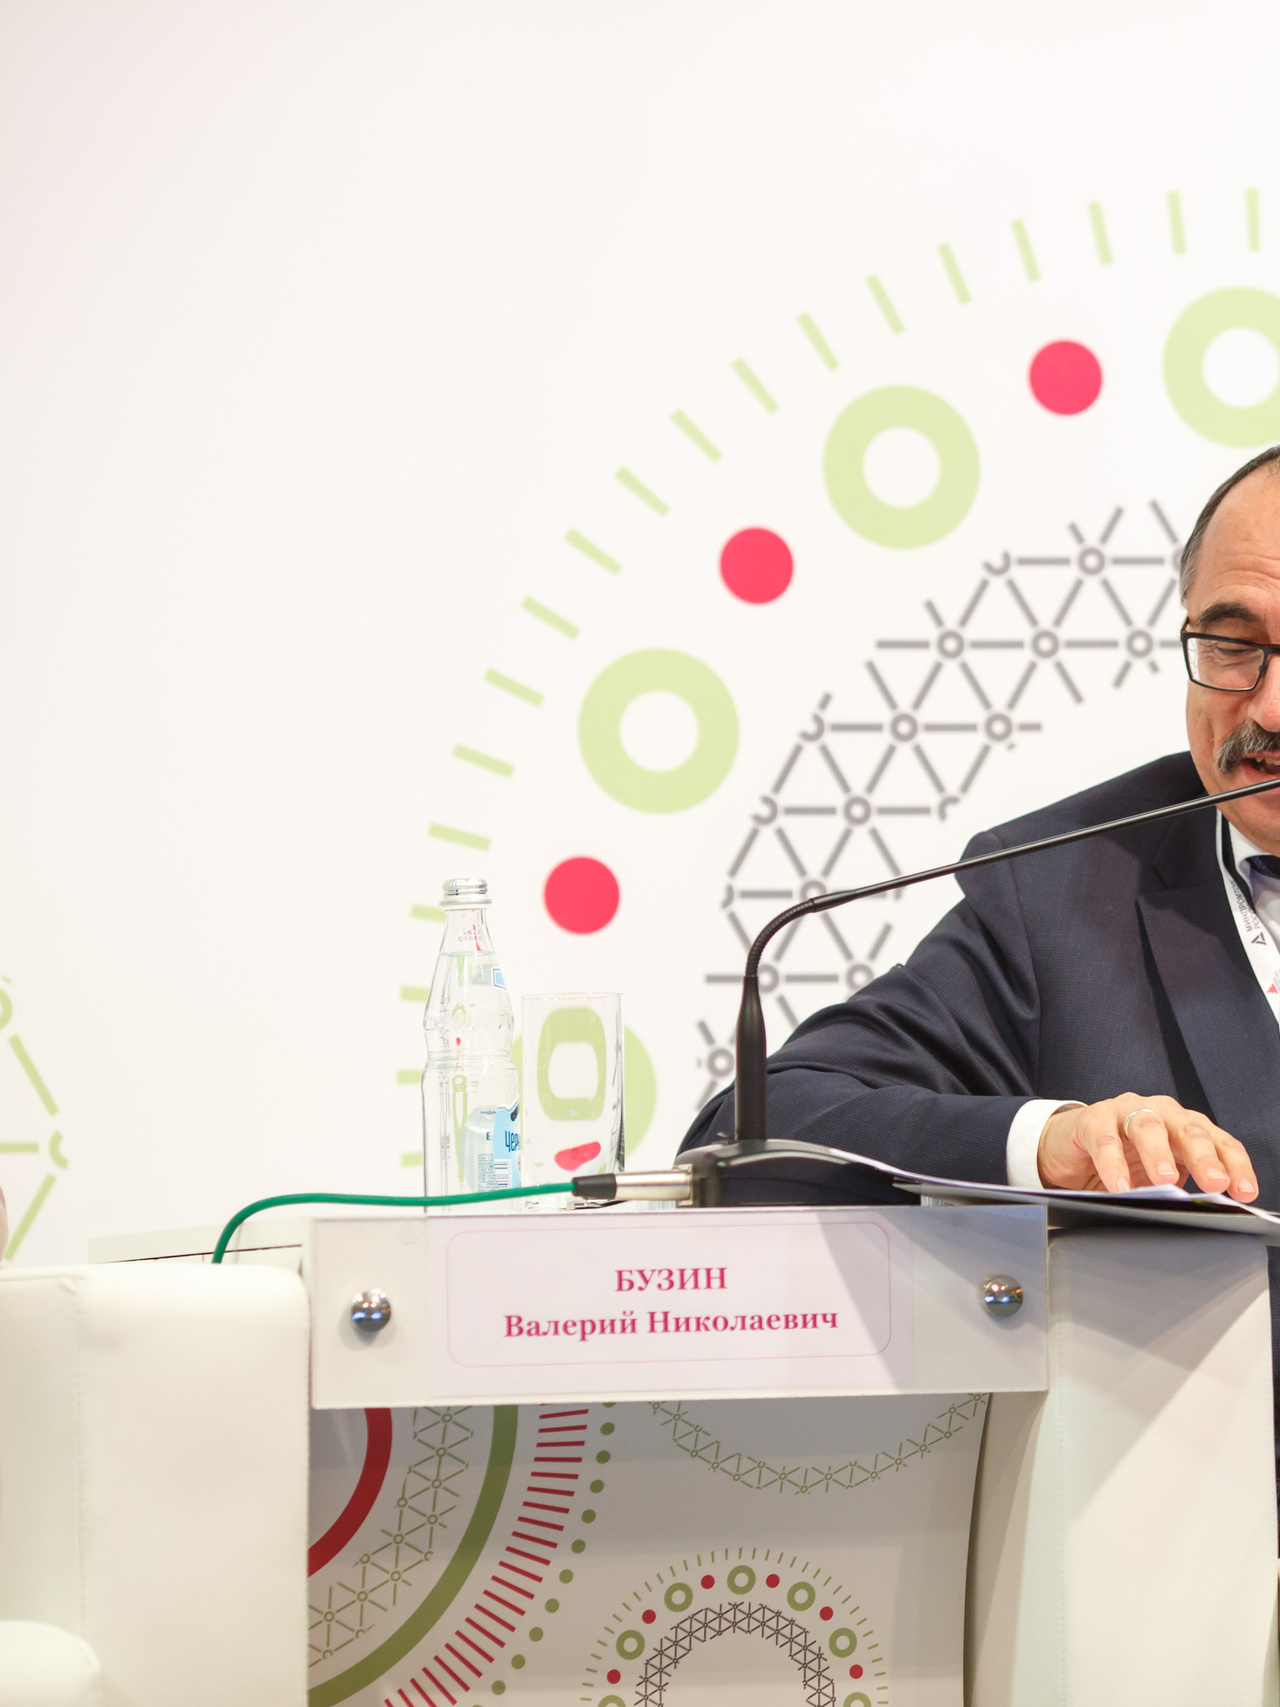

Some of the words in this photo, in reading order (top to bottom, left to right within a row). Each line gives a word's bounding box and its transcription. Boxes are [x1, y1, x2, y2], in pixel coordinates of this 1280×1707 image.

[615, 1267, 728, 1292] БУЗИН
[504, 1310, 638, 1342] Валерий
[647, 1310, 839, 1334] Николаевич
